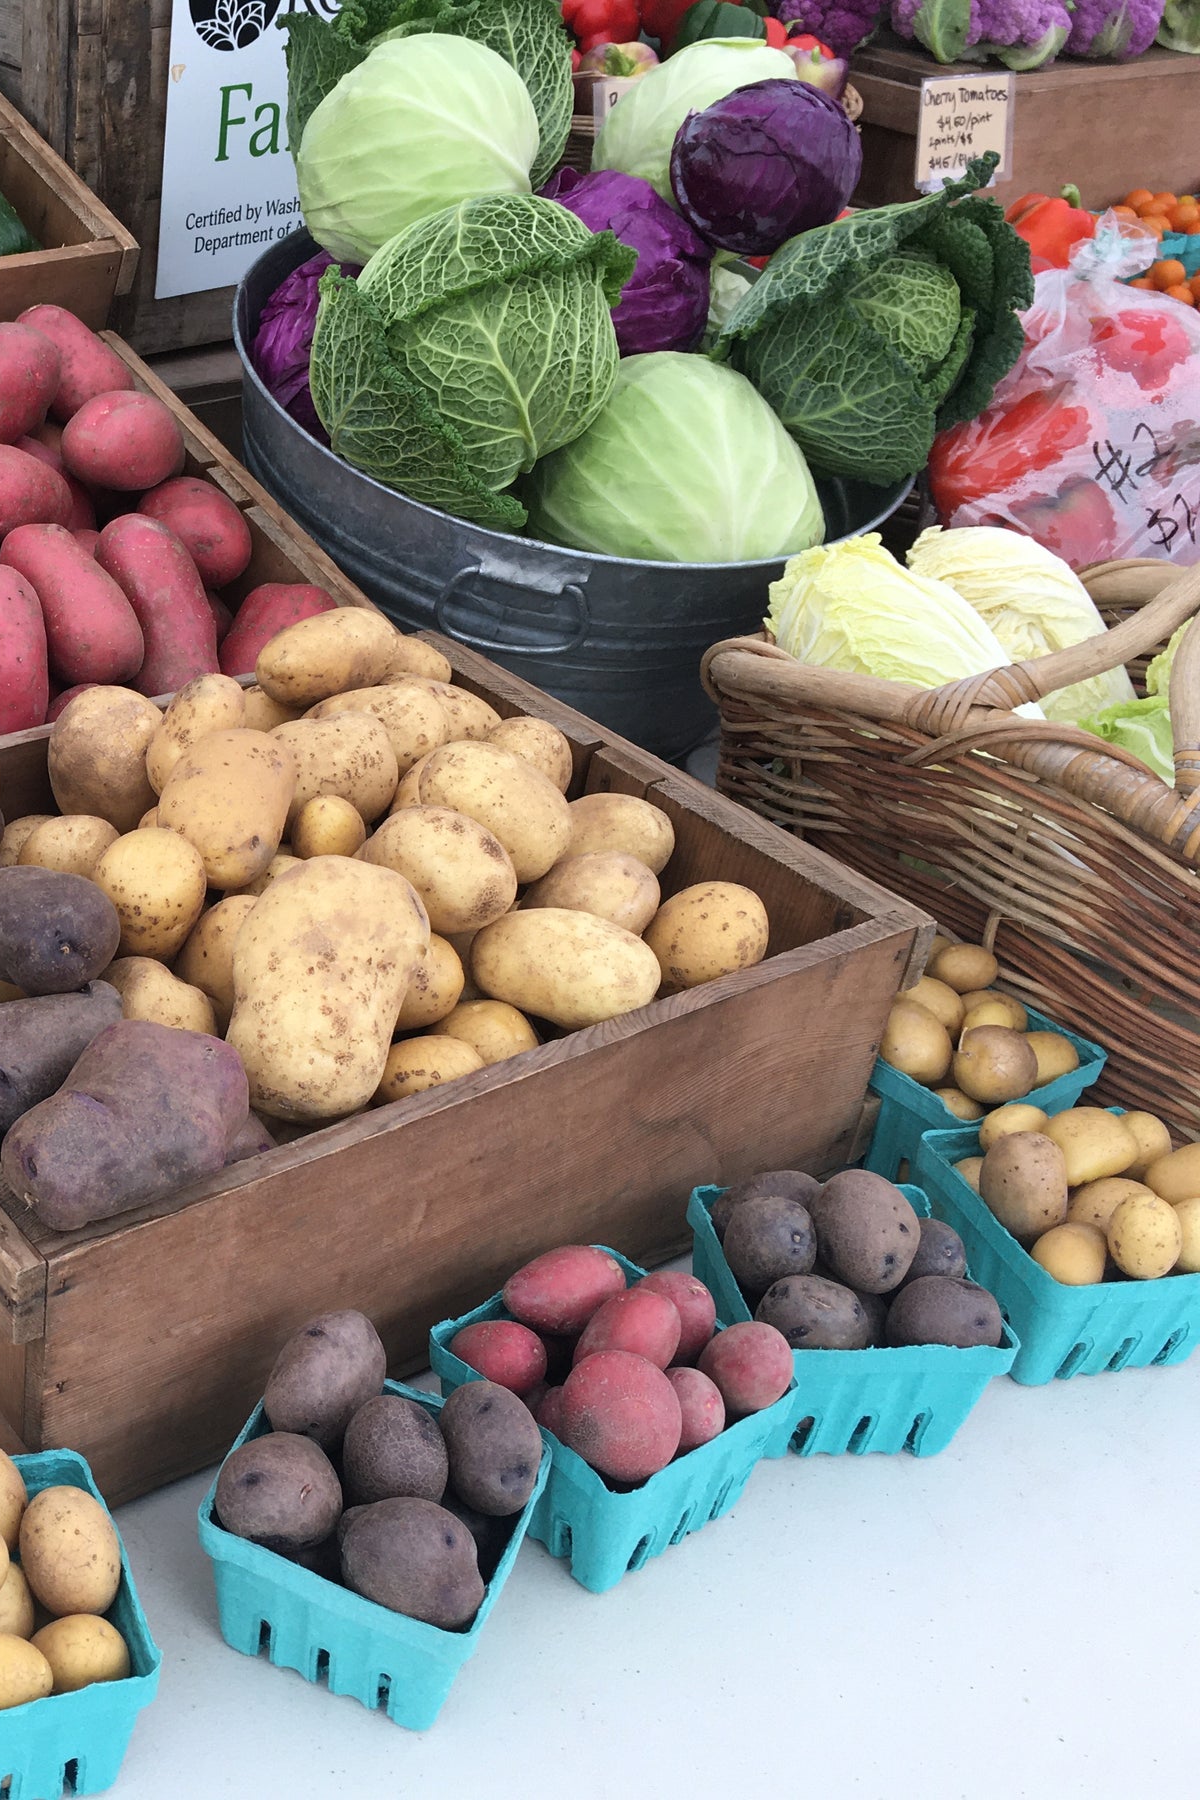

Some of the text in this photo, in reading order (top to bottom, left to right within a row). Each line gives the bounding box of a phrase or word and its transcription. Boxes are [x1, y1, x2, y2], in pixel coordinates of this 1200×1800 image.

[924, 84, 1008, 113] Cherry Tomatoes
[215, 83, 291, 162] Fa
[186, 204, 242, 230] Certified
[246, 203, 263, 223] by
[194, 226, 273, 255] Department
[277, 221, 292, 239] of
